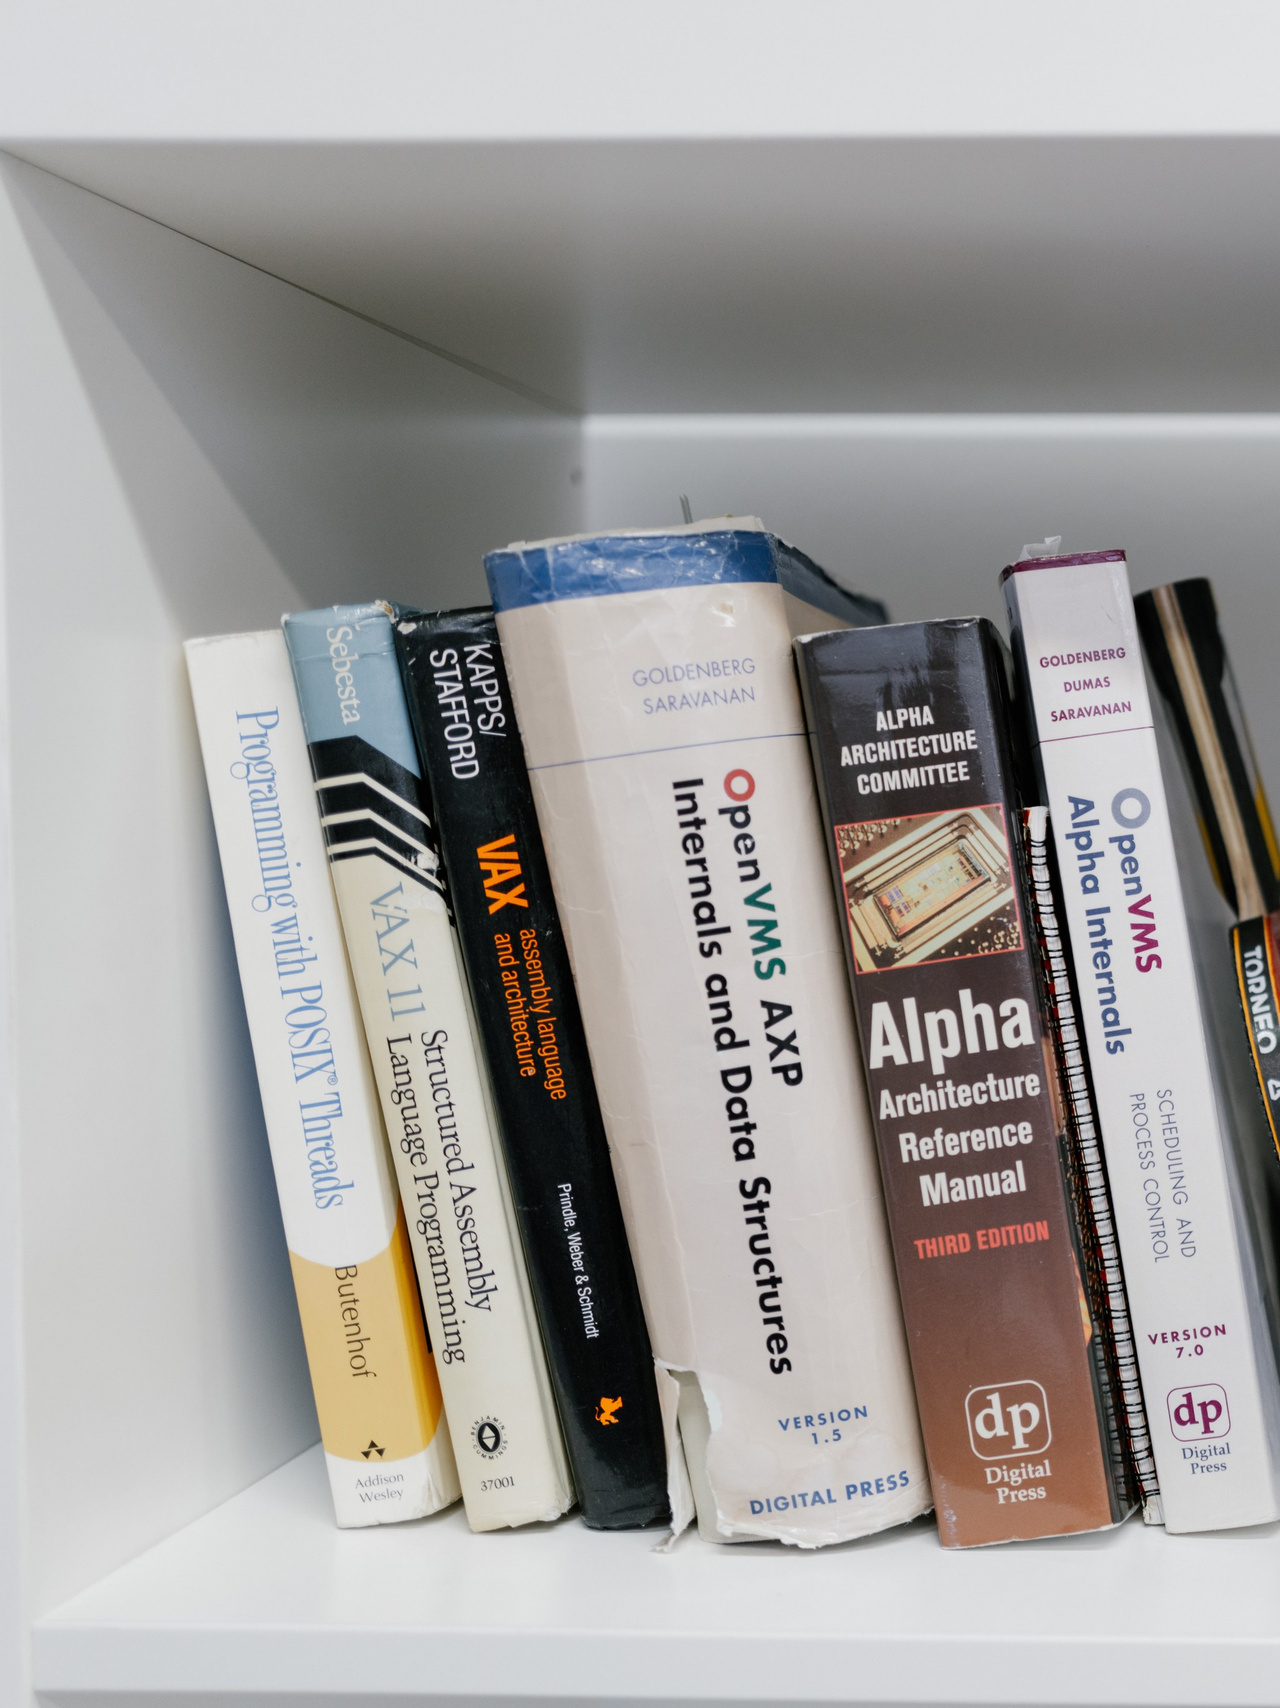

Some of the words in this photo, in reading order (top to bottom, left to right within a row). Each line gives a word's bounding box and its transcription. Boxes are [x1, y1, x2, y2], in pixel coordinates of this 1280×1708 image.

[326, 626, 361, 726] Sebesta
[633, 658, 755, 687] GOLDENBERG
[1040, 647, 1126, 668] GOLDENBERG
[463, 643, 506, 738] KAPPS/
[643, 687, 755, 714] SARAVANAN
[1063, 676, 1111, 693] DUMAS
[430, 649, 480, 780] STAFFORD
[875, 705, 934, 731] ALPHA
[1051, 701, 1132, 722] SARAVANAN
[840, 730, 978, 767] ARCHITECTURE
[857, 761, 970, 795] COMMITTEE
[476, 834, 528, 915] VAX
[672, 778, 731, 959] Internals
[1108, 787, 1162, 973] OpenVMS
[369, 881, 418, 975] VAX
[718, 769, 787, 981] OpenVMS
[760, 999, 803, 1086] AXP
[1065, 795, 1105, 895] Alpha
[1085, 906, 1132, 1055] Internals
[230, 706, 300, 913] Programming
[270, 913, 318, 979] with
[300, 1091, 355, 1210] Threads
[494, 933, 515, 966] and
[501, 967, 537, 1077] architecture
[519, 928, 552, 1015] assembly
[537, 1017, 566, 1100] language
[705, 973, 750, 1053] and
[1244, 945, 1277, 1054] TORNEO
[869, 989, 1035, 1075] Alpha
[720, 1065, 757, 1162] Data
[879, 1072, 1040, 1120] Architecture
[899, 1121, 1033, 1163] Reference
[1130, 1093, 1156, 1170] PROCESS
[420, 1030, 475, 1174] Structured
[449, 1180, 499, 1313] Assembly
[919, 1160, 1026, 1207] Manual
[1156, 1089, 1188, 1205] SCHEDULING
[1176, 1218, 1196, 1258] AND
[387, 1034, 428, 1168] Language
[413, 1171, 466, 1365] Programming
[558, 1183, 576, 1232] Prindle,
[1142, 1178, 1169, 1263] CONTROL
[567, 1232, 585, 1274] Weber
[914, 1234, 970, 1260] THIRD
[977, 1220, 1049, 1250] EDITION
[576, 1275, 589, 1287] &
[739, 1176, 792, 1375] Structures
[334, 1265, 376, 1378] Butenhof
[577, 1288, 599, 1339] Schmidt
[1148, 1324, 1227, 1346] VERSION
[1176, 1344, 1204, 1359] 7.0
[778, 1405, 869, 1431] VERSION
[974, 1392, 1041, 1450] dp
[1173, 1391, 1223, 1435] dp
[811, 1429, 842, 1445] 1.5
[1182, 1442, 1231, 1462] Digital
[355, 1472, 404, 1490] Addison
[481, 1476, 515, 1491] 37001
[984, 1460, 1051, 1488] Digital
[1190, 1459, 1227, 1475] Press
[359, 1487, 404, 1503] Wesley
[750, 1488, 836, 1514] DIGITAL
[846, 1470, 910, 1500] PRESS
[996, 1484, 1046, 1504] Press
